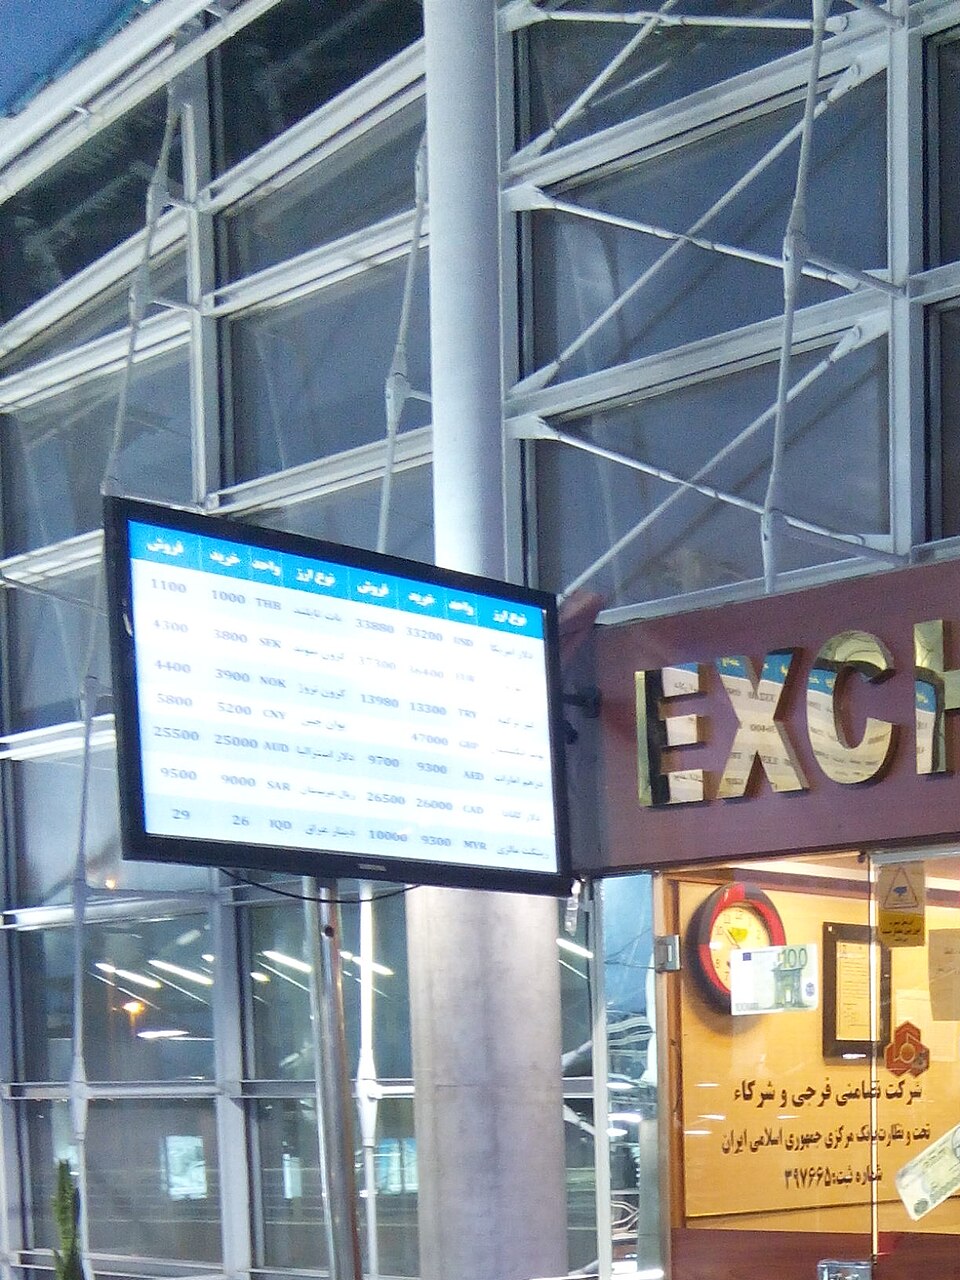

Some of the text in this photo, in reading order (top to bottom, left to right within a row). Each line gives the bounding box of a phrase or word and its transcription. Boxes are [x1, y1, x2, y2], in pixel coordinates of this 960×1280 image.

[151, 578, 187, 593] 1100
[211, 589, 246, 604] 1000
[153, 619, 189, 633] 4300
[354, 618, 395, 634] 33880
[213, 629, 248, 643] 3800
[405, 626, 443, 642] 33200
[154, 659, 191, 674] 4400
[214, 668, 250, 683] 3900
[156, 692, 193, 707] 5800
[360, 693, 399, 708] 13980
[216, 701, 253, 716] 5200
[408, 702, 448, 716] 13300
[153, 725, 200, 741] 25500
[411, 732, 449, 746] 47000
[214, 733, 259, 749] 25000
[263, 741, 290, 753] AUD
[367, 754, 400, 768] 9700
[416, 761, 448, 775] 9300
[160, 767, 198, 781] 9500
[220, 774, 257, 788] 9000
[266, 780, 291, 792] SAR
[366, 791, 406, 806] 26500
[415, 797, 454, 811] 26000
[171, 808, 191, 820] 29
[231, 814, 250, 827] 26
[268, 818, 293, 831] IQD
[368, 829, 408, 843] 10000
[420, 834, 452, 848] 9300
[781, 947, 808, 969] 100
[734, 1079, 776, 1109] شرکاء
[779, 1088, 788, 1108] و
[792, 1077, 832, 1108] فرجی
[885, 1079, 922, 1105] شرکت
[749, 1125, 784, 1152] اسلامی
[824, 1124, 854, 1149] مرکزی
[878, 1122, 905, 1147] نظارت
[905, 1128, 912, 1146] و
[913, 1123, 931, 1140] تحت
[721, 1127, 748, 1154] ایران
[785, 1129, 822, 1151] جمهوری
